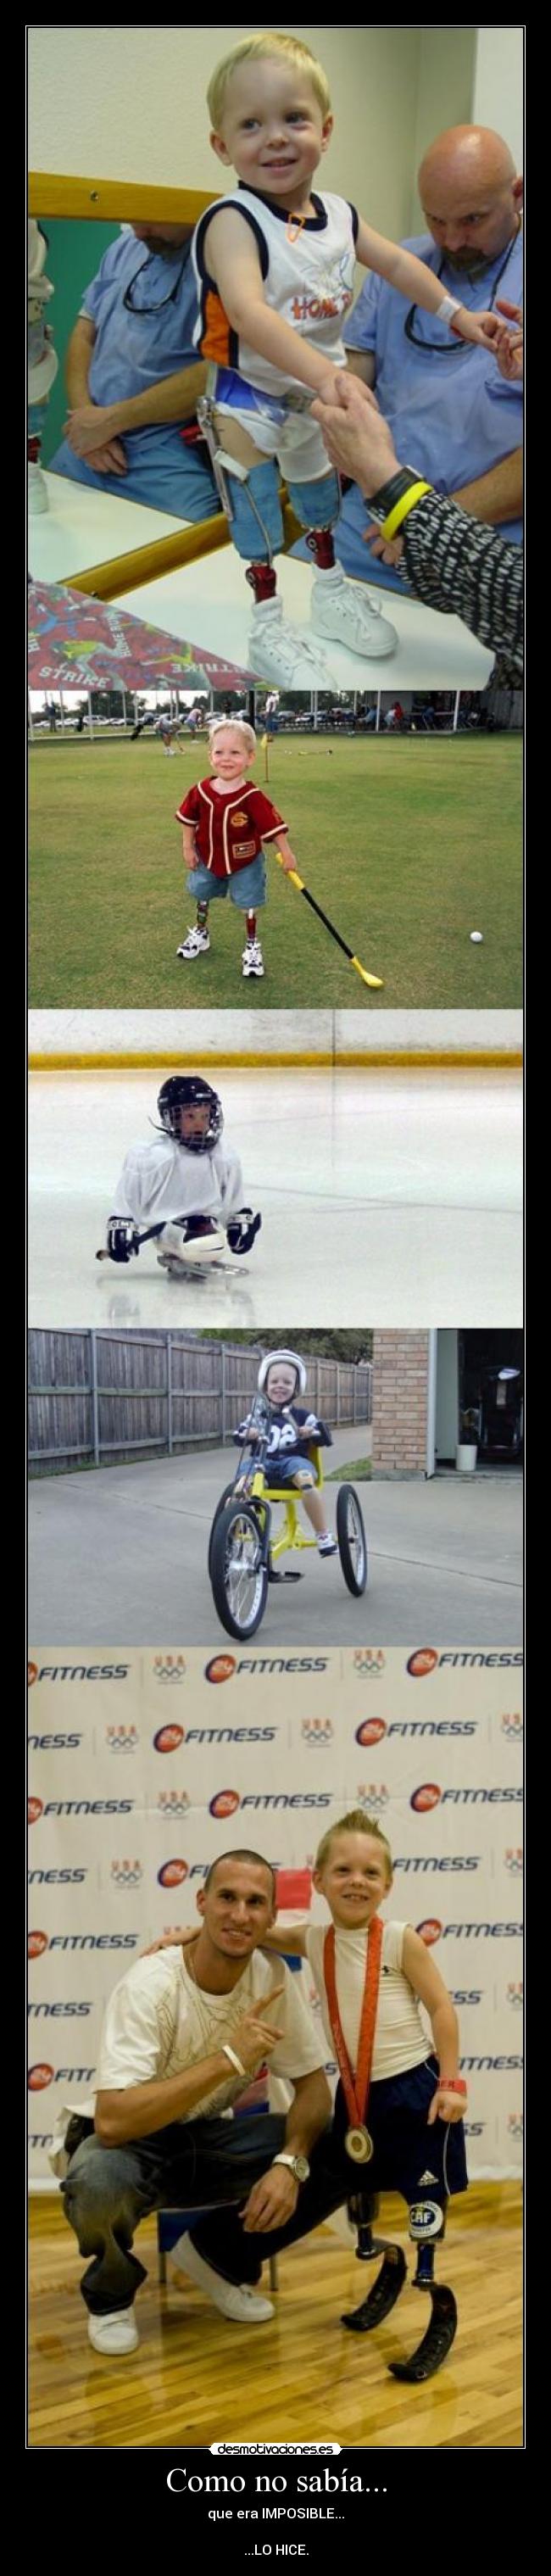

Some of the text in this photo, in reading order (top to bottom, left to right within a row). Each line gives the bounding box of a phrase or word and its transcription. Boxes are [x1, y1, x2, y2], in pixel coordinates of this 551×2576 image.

[39, 662, 110, 689] STRIKE
[38, 1664, 131, 1681] FITNESS
[237, 1657, 329, 1674] FITNESS
[185, 1726, 277, 1743] FITNESS
[387, 1721, 478, 1737] FITNESS
[43, 1799, 136, 1815] FITNESS
[240, 1793, 333, 1809] FITNESS
[393, 1856, 481, 1872] FITNESS
[28, 1868, 87, 1884] NESS
[48, 1934, 140, 1950] FITNESS
